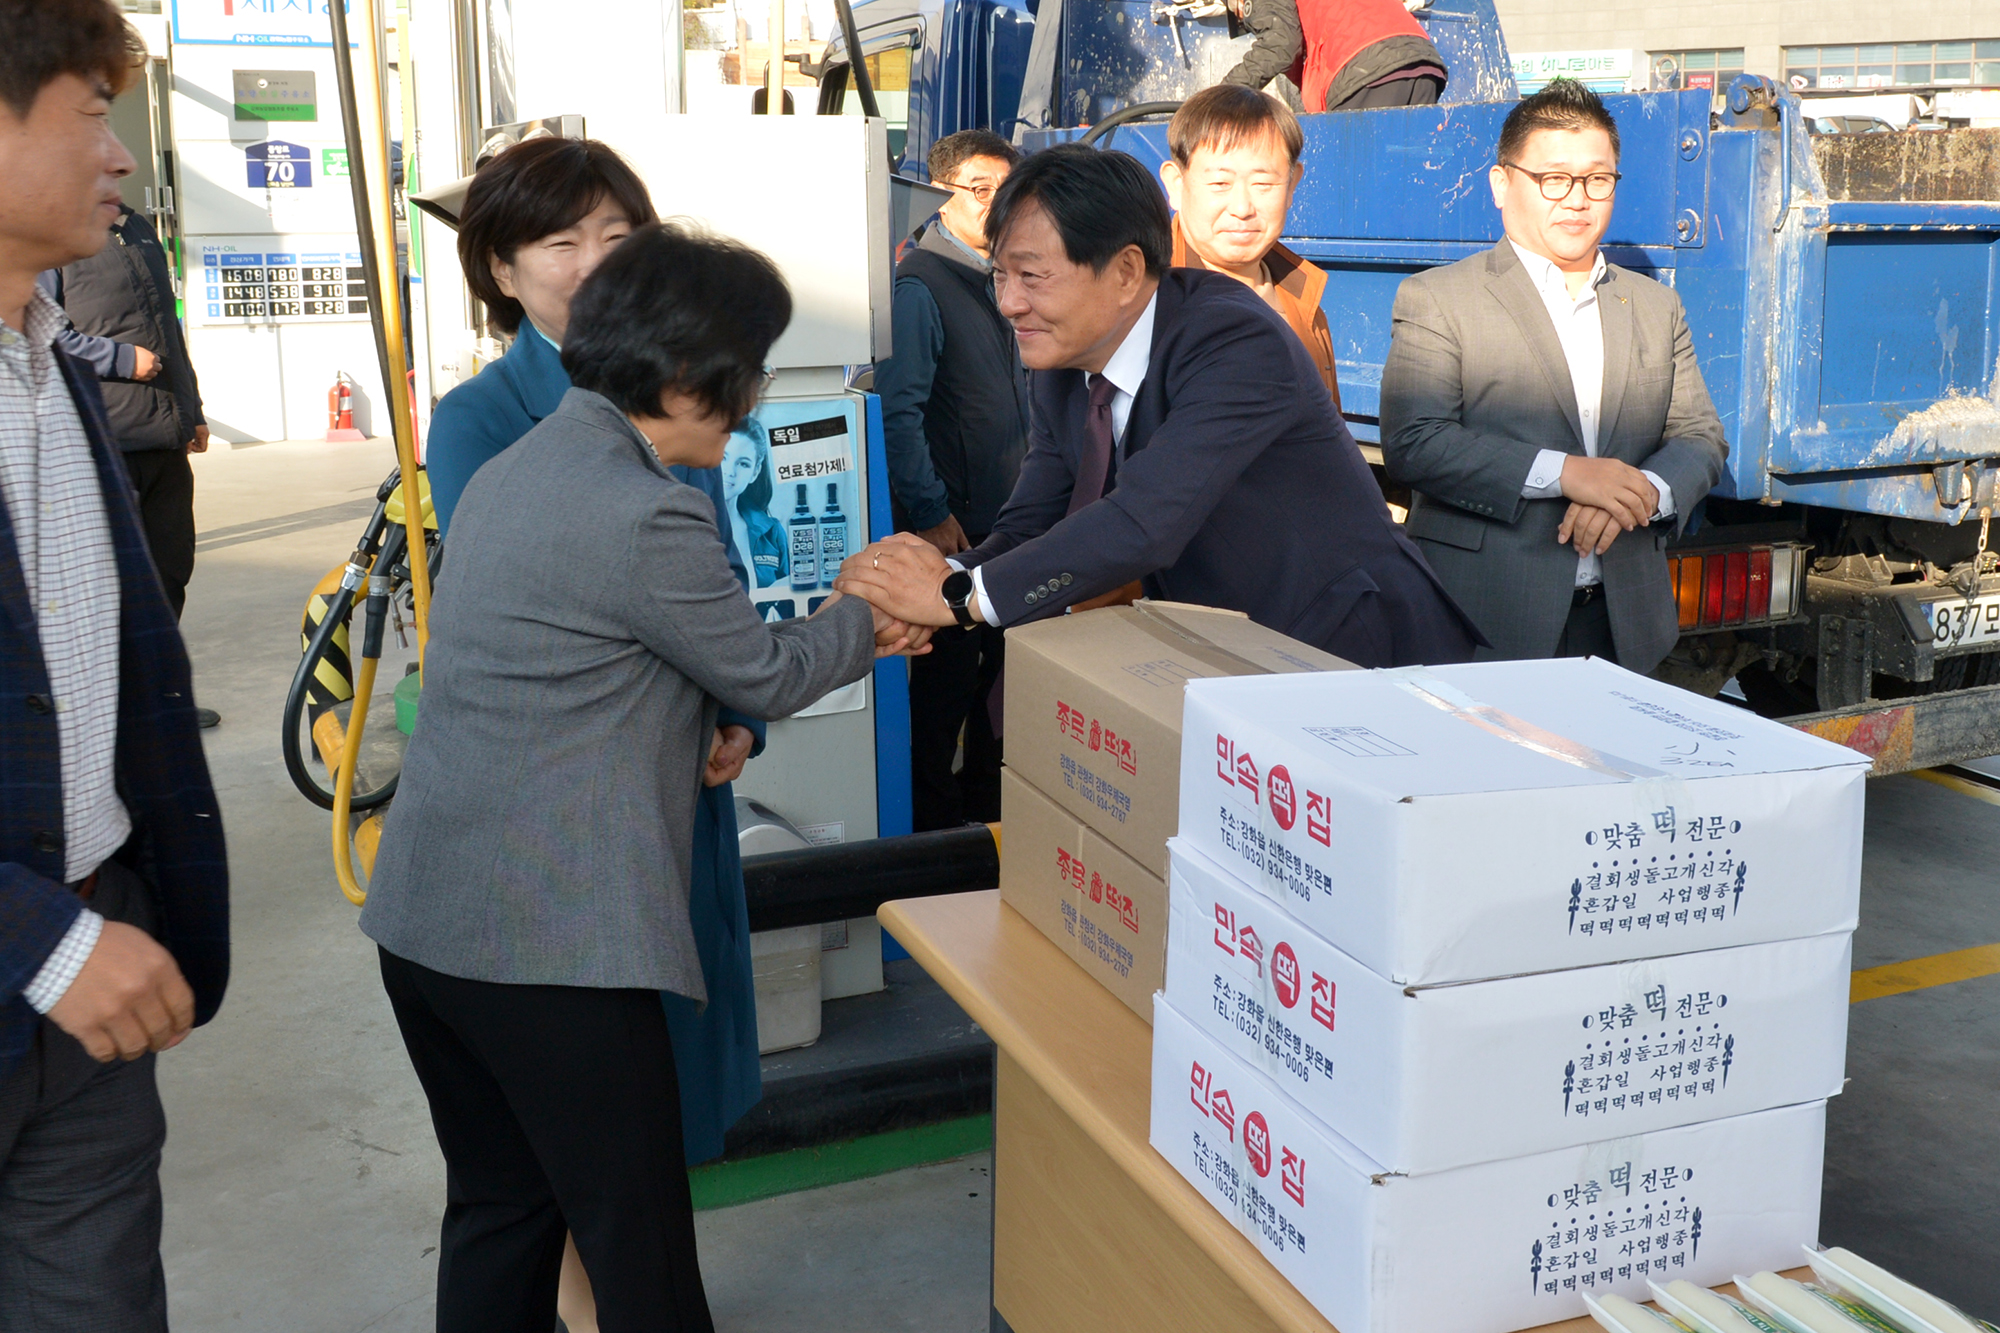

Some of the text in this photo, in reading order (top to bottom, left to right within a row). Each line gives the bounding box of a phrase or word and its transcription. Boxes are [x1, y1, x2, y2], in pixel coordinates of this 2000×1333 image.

[264, 161, 295, 181] 70
[227, 269, 263, 281] 1608
[268, 269, 298, 281] 780
[312, 268, 341, 280] 828
[228, 286, 264, 299] 1448
[269, 286, 299, 298] 538
[313, 284, 343, 298] 910
[229, 303, 265, 316] 1100
[274, 302, 300, 315] 172
[314, 301, 344, 314] 928
[773, 427, 801, 443] 독일
[778, 457, 846, 480] 연료첨가제!
[793, 542, 813, 550] D28
[823, 540, 843, 548] G26
[1056, 700, 1137, 776] 종로 떡집
[1059, 753, 1076, 776] 강화읍
[1096, 794, 1127, 824] 934-2787
[1603, 805, 1726, 851] 맞춤 떡 전문
[1267, 858, 1311, 902] 934-0006
[1268, 838, 1302, 876] 신한은행
[1304, 859, 1333, 896] 맞은편
[1056, 846, 1139, 934] 종로 떡집
[1060, 899, 1078, 924] 강화읍
[1097, 947, 1130, 979] 934-2787
[1599, 984, 1713, 1032] 맞춤 떡 전문
[1264, 1035, 1309, 1083] 934-0006
[1267, 1016, 1302, 1055] 신한은행
[1304, 1043, 1334, 1080] 맞은편
[1563, 1161, 1678, 1210] 맞춤 떡 전문
[1278, 1214, 1306, 1254] 맞은편
